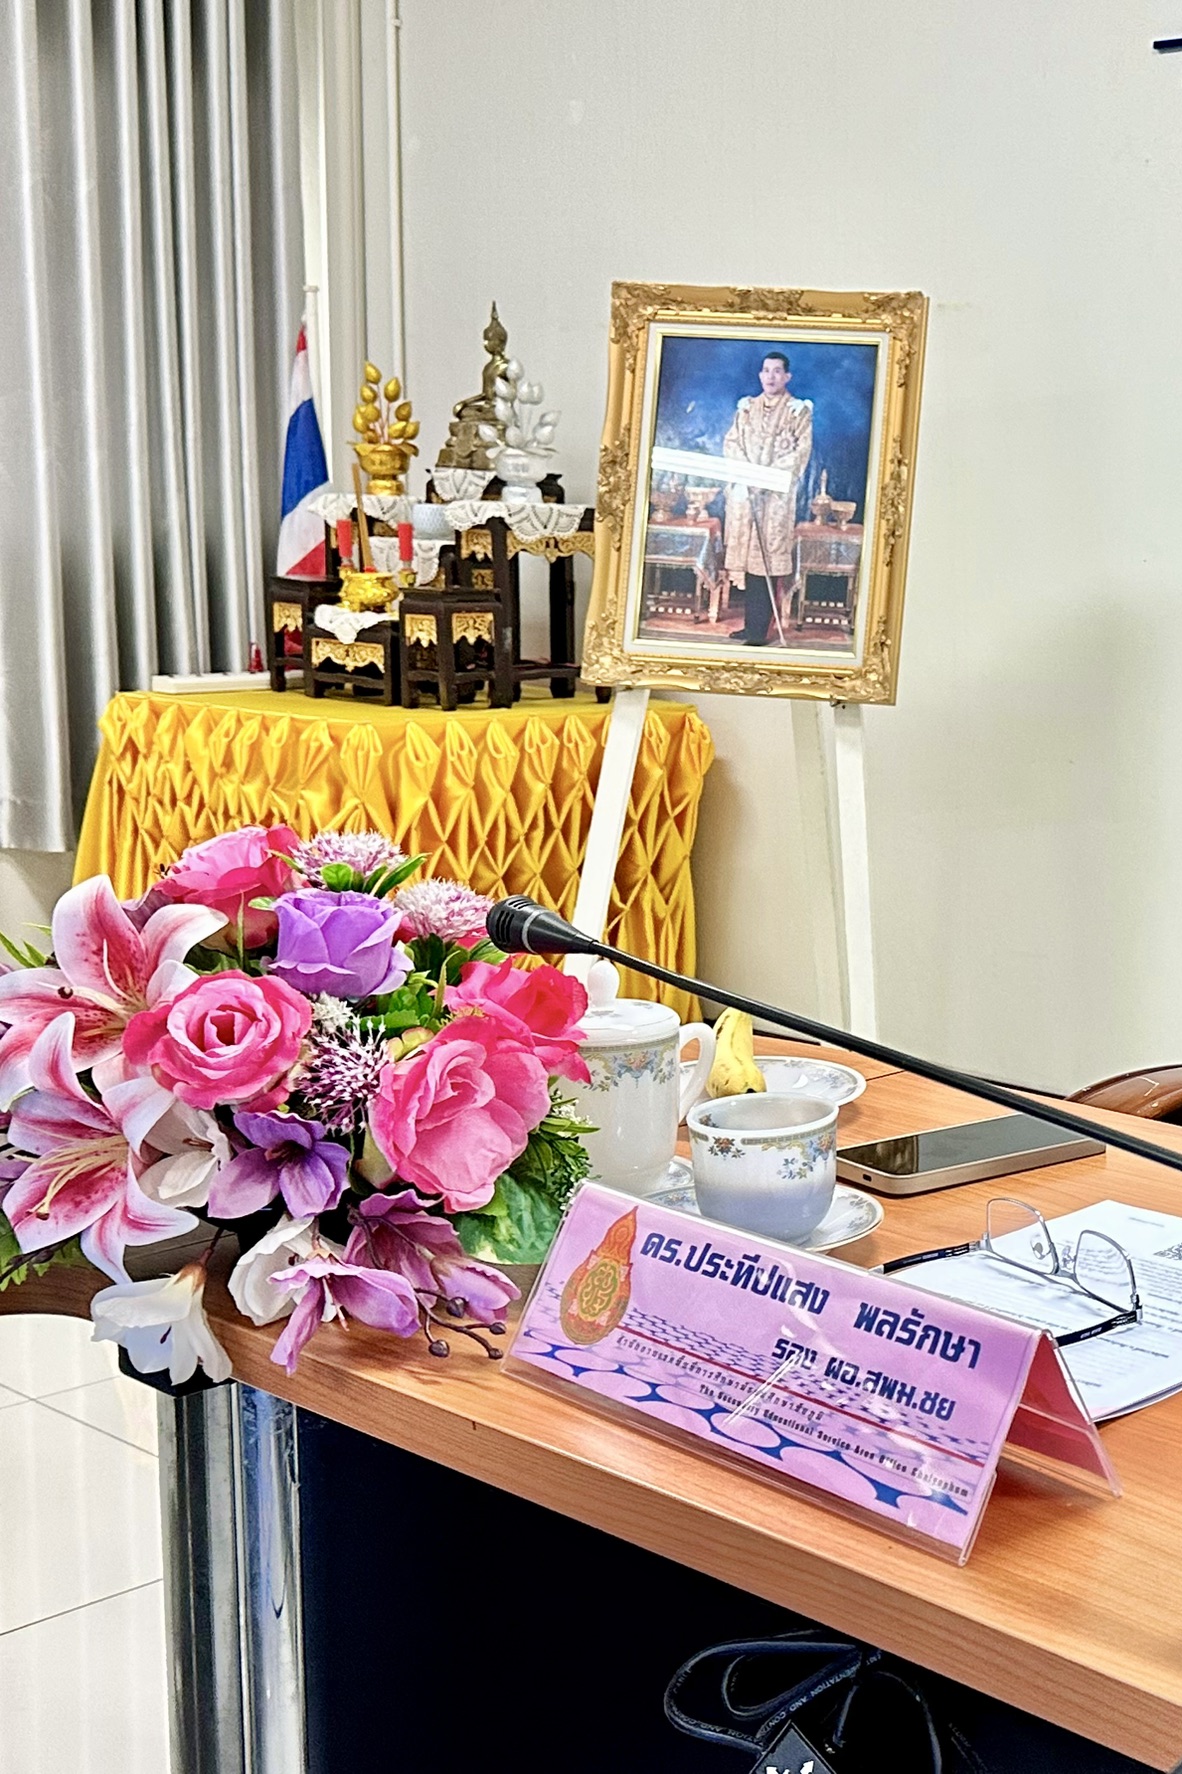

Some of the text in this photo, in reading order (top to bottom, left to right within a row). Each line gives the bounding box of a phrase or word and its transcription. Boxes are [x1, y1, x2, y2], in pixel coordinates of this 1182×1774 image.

[640, 1232, 981, 1370] ดร.ประทีปแสง พลรักษา
[700, 1384, 715, 1399] The
[717, 1391, 760, 1415] Seconry
[763, 1409, 813, 1436] Educational
[817, 1430, 851, 1451] Service
[824, 1357, 956, 1421] ผอ.สพม.ชย
